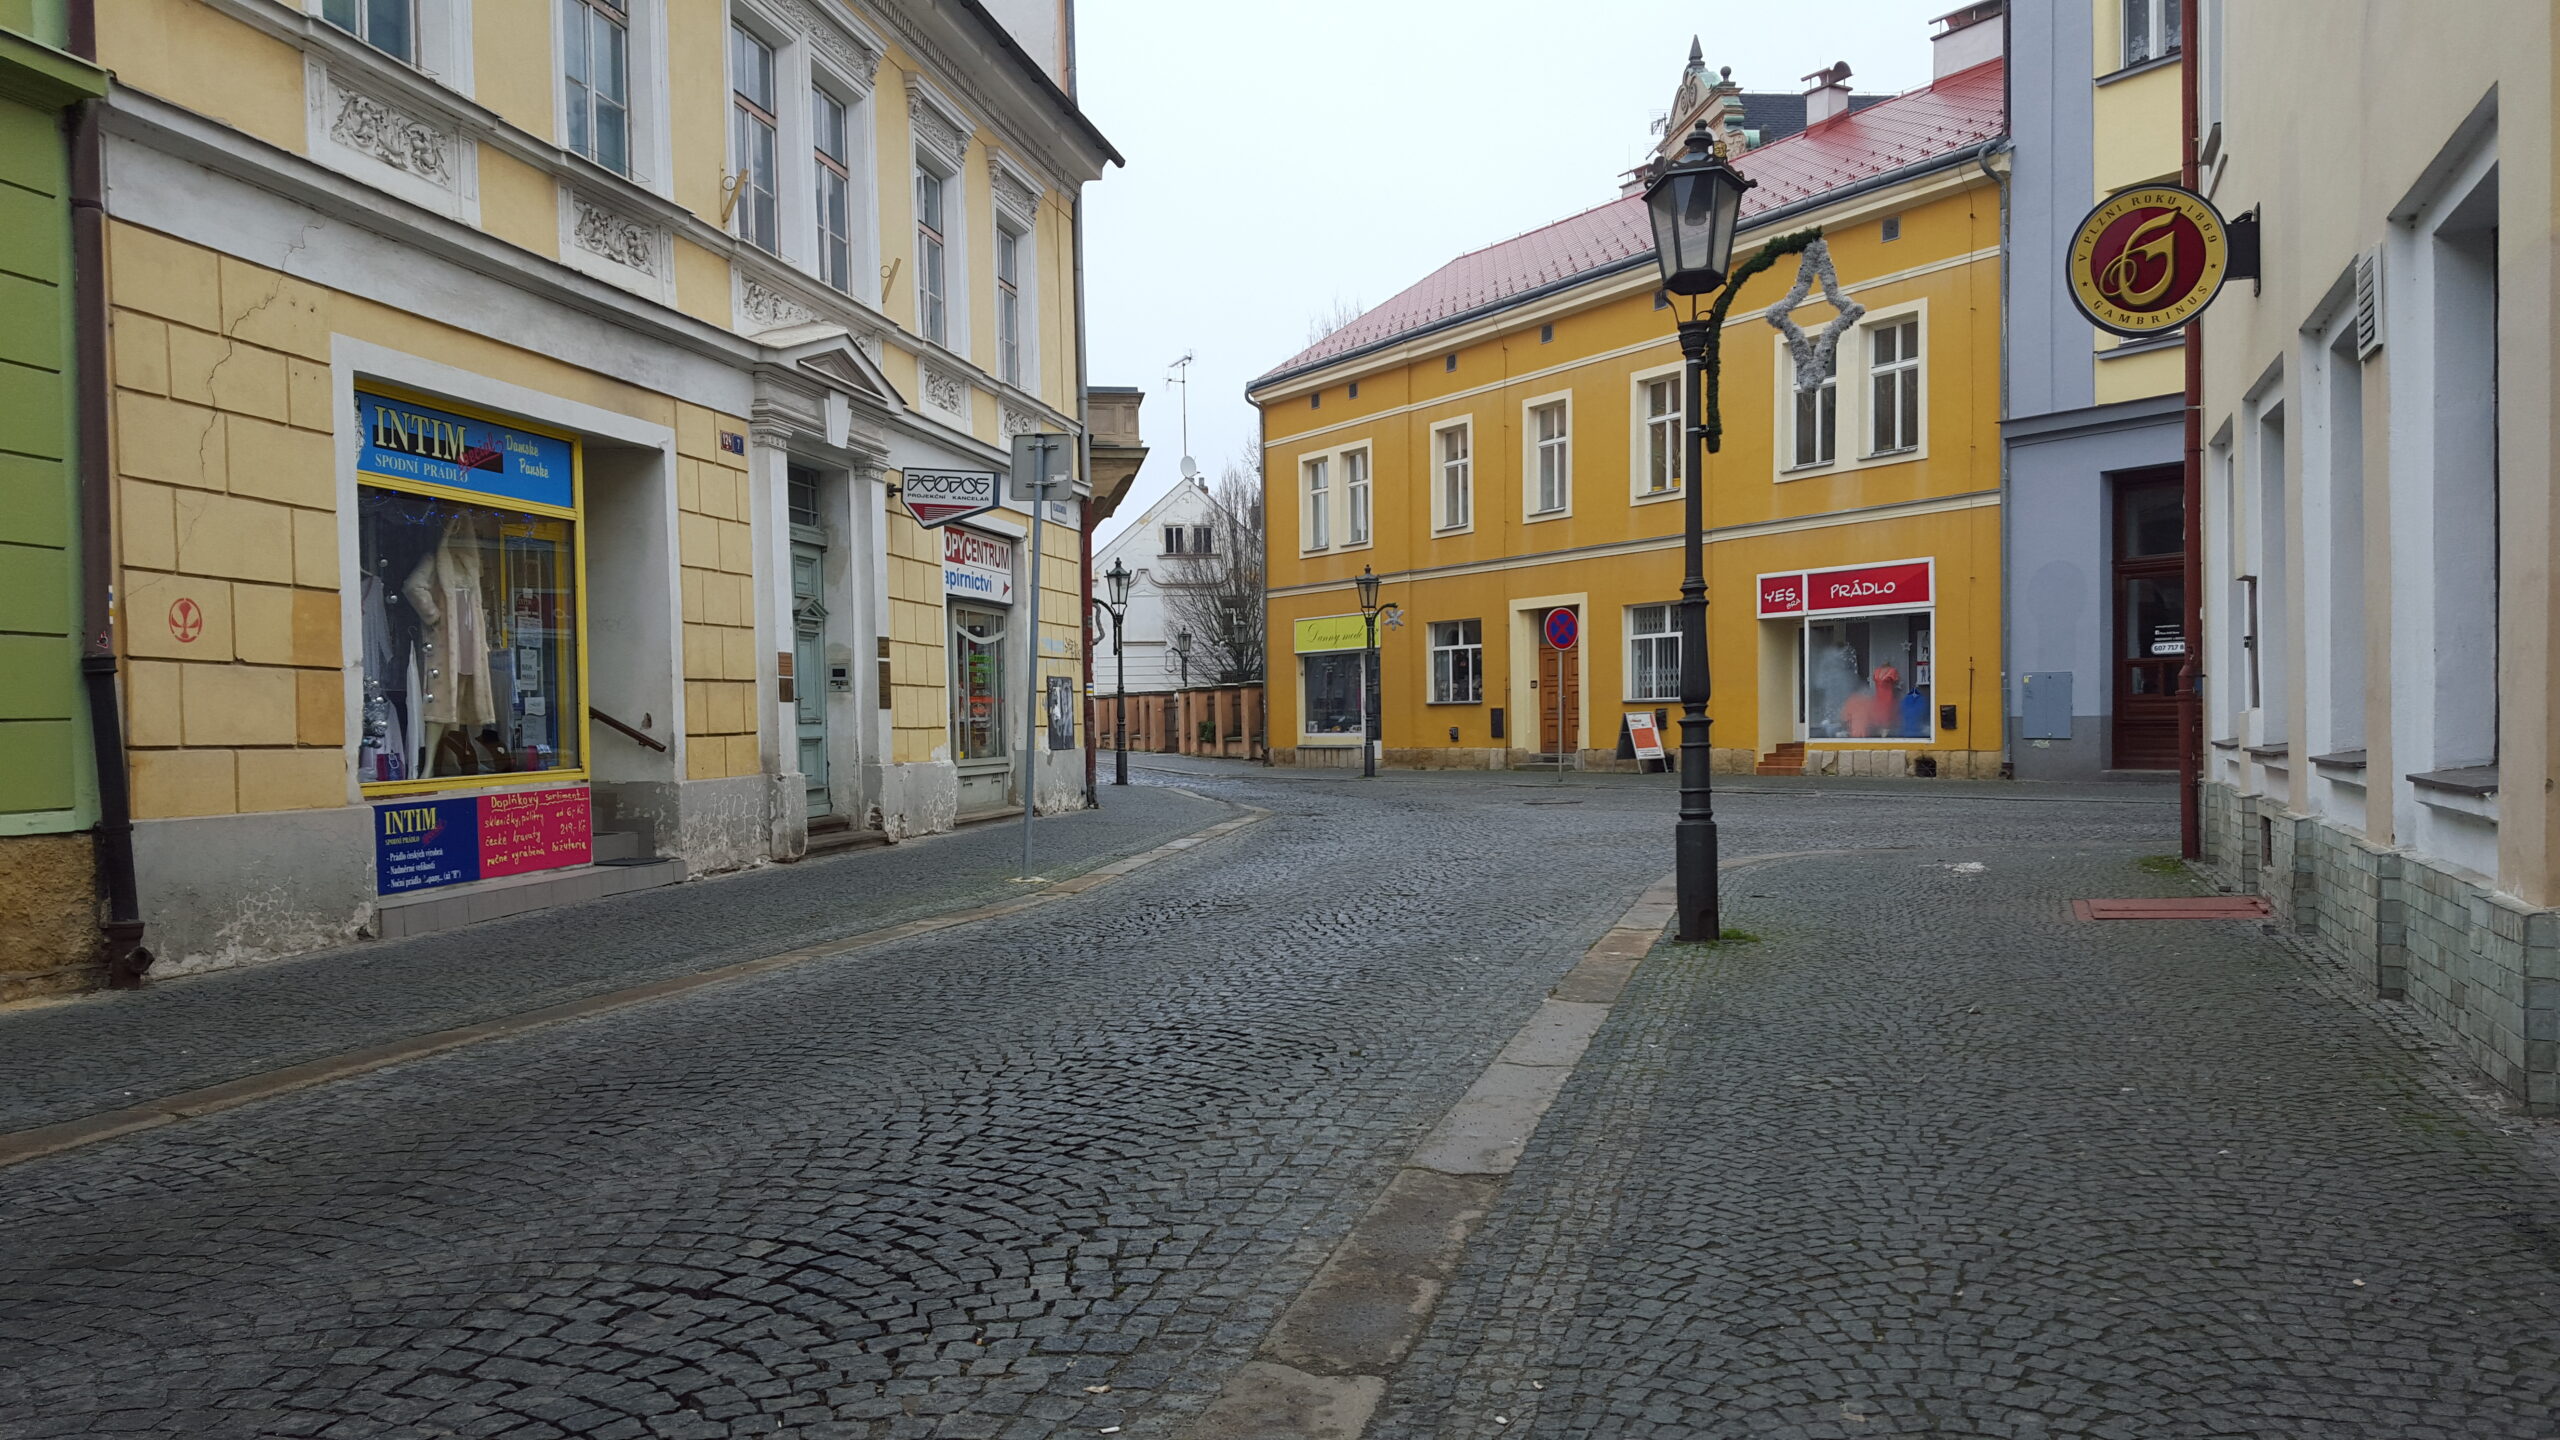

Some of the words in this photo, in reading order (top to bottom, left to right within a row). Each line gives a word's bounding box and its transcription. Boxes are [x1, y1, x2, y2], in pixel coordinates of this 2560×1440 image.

[2084, 204, 2122, 244] PLZNI
[2132, 194, 2177, 206] ROKU
[2186, 204, 2217, 244] 1869
[2094, 286, 2208, 325] GAMBRINUS
[375, 405, 467, 463] INTIM
[375, 453, 419, 475] SPODNÍ
[423, 462, 468, 483] PRÁDLO
[944, 531, 1009, 570] OPYCENTRUM
[945, 567, 993, 593] apírnictví
[1830, 579, 1896, 599] PRÁDLO
[1764, 587, 1796, 603] YES
[491, 792, 539, 811] Doplňkový
[384, 807, 437, 835] INTIM
